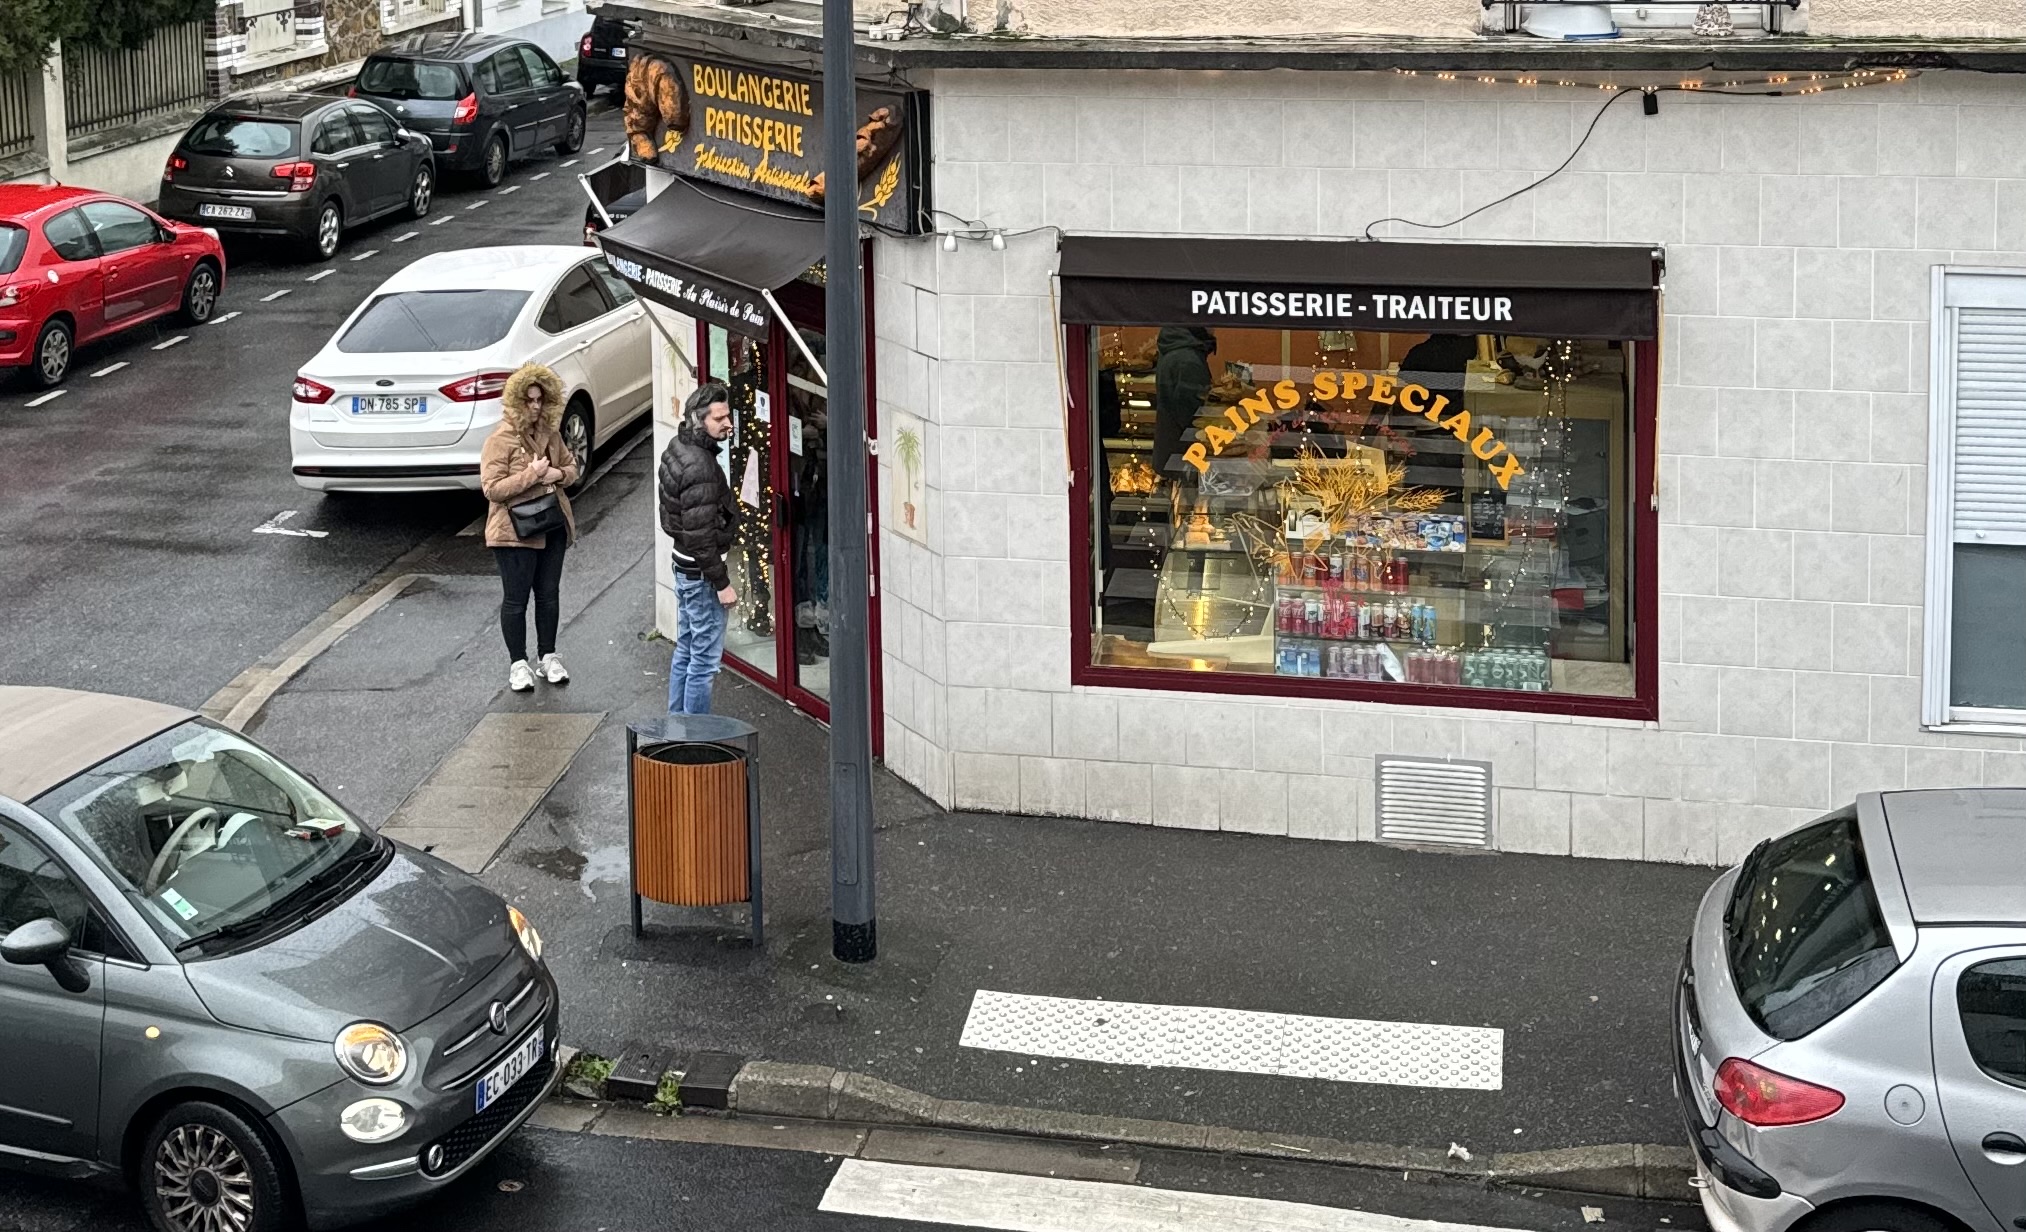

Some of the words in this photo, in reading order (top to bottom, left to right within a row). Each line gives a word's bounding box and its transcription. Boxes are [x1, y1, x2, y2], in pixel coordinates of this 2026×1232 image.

[693, 64, 813, 116] BOULANGERIE
[705, 106, 804, 157] PATISSERIE
[645, 267, 683, 298] PATISSERIE
[698, 288, 729, 314] Plaisir
[729, 300, 740, 318] de
[1191, 290, 1353, 317] PATISSERIE
[1372, 294, 1513, 322] TRAITEUR
[1182, 379, 1301, 474] PAINS
[1313, 371, 1525, 491] SPECIAUX
